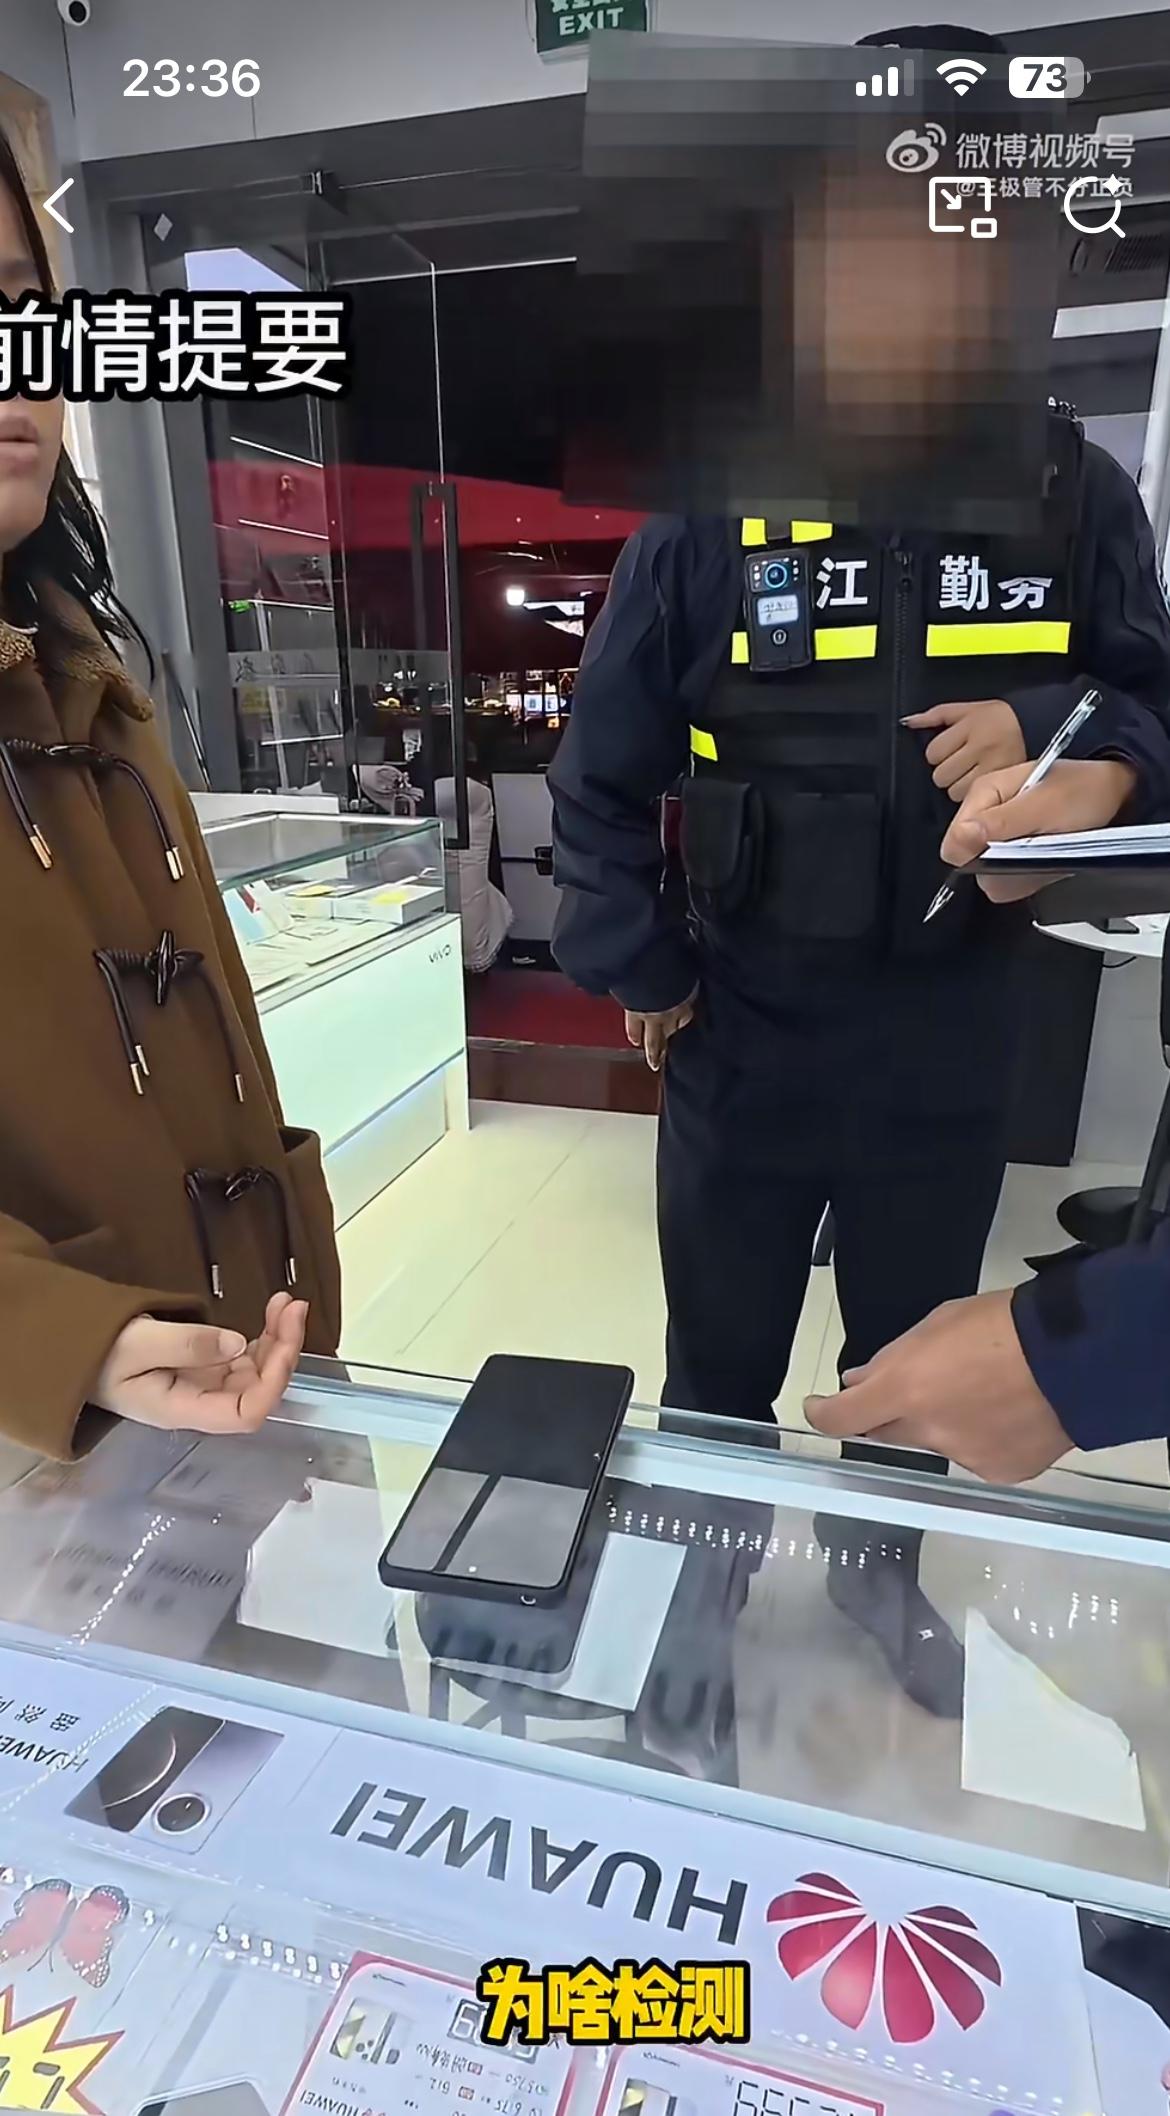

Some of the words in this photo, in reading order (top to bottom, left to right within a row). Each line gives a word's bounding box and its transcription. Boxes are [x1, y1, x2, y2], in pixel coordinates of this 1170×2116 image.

[560, 7, 624, 36] EXIT
[816, 557, 868, 609] 江
[0, 1735, 88, 1773] HUAWE
[331, 1781, 749, 1946] HUAWEI
